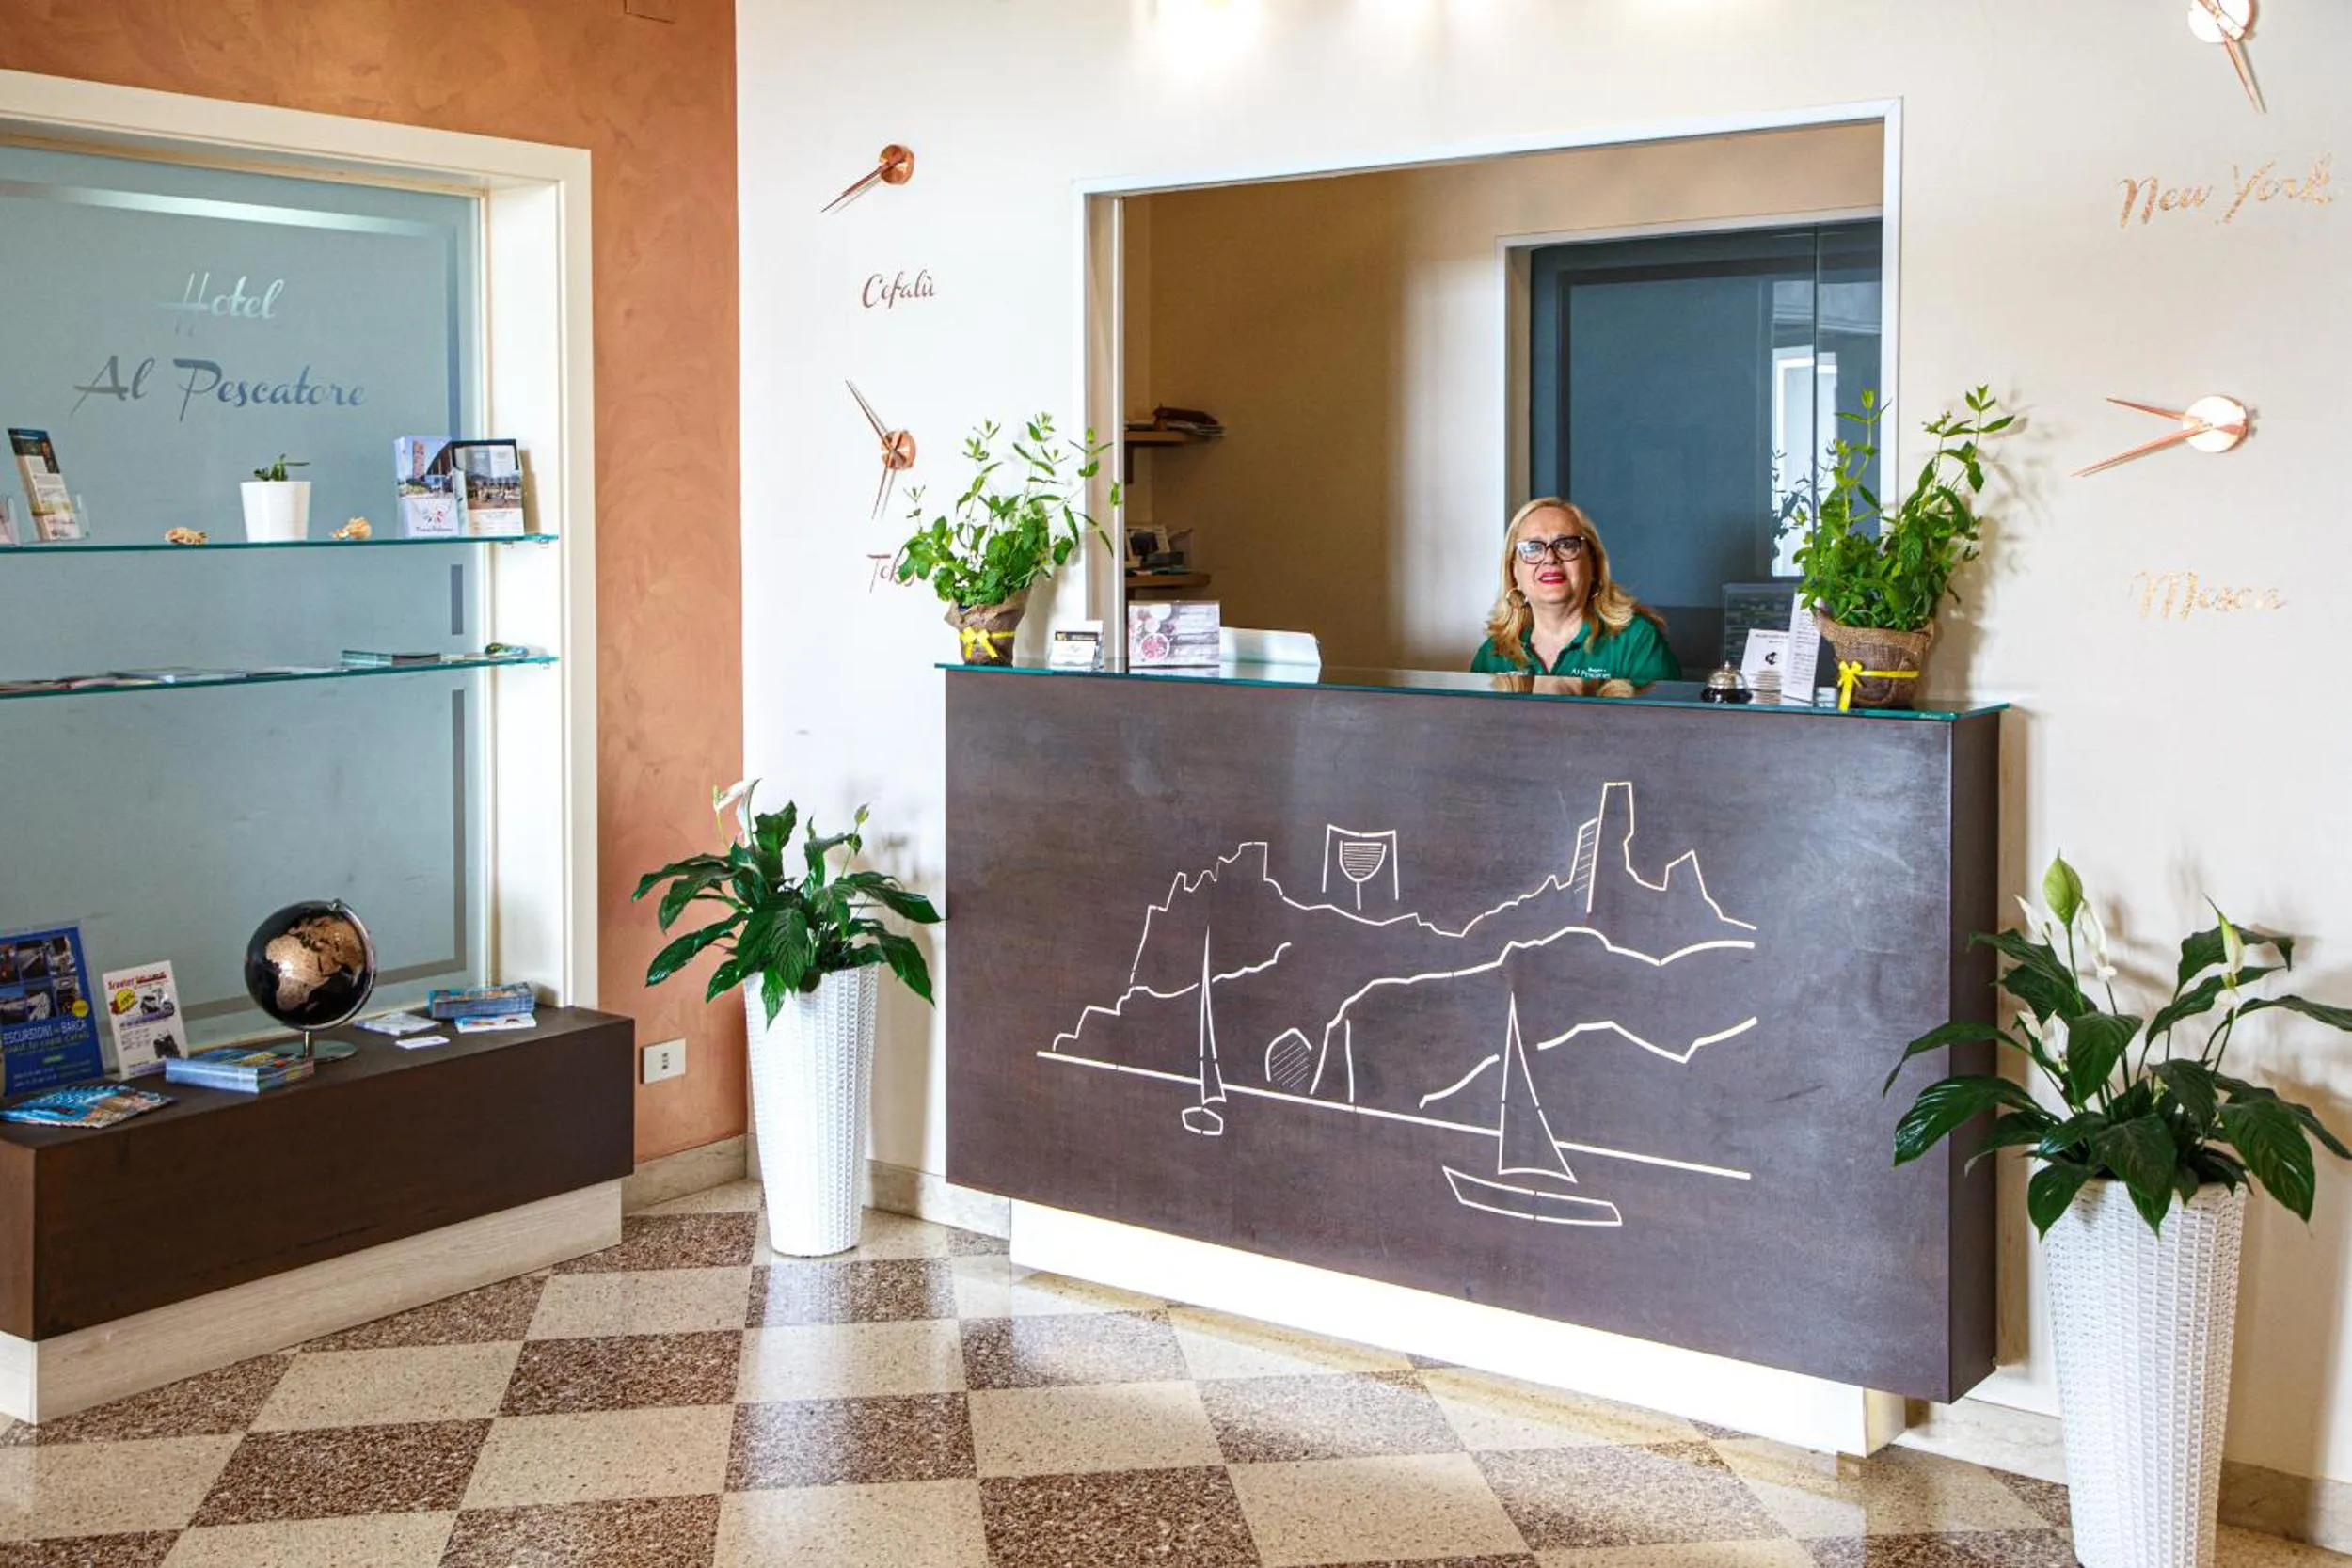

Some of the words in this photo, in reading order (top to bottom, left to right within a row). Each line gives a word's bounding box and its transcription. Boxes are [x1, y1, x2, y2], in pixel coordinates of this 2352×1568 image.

[2119, 175, 2213, 229] New
[2214, 153, 2335, 225] York
[157, 271, 284, 336] Hotel
[862, 268, 935, 309] Cefalù
[70, 356, 155, 416] Al
[173, 357, 369, 423] Pescatore
